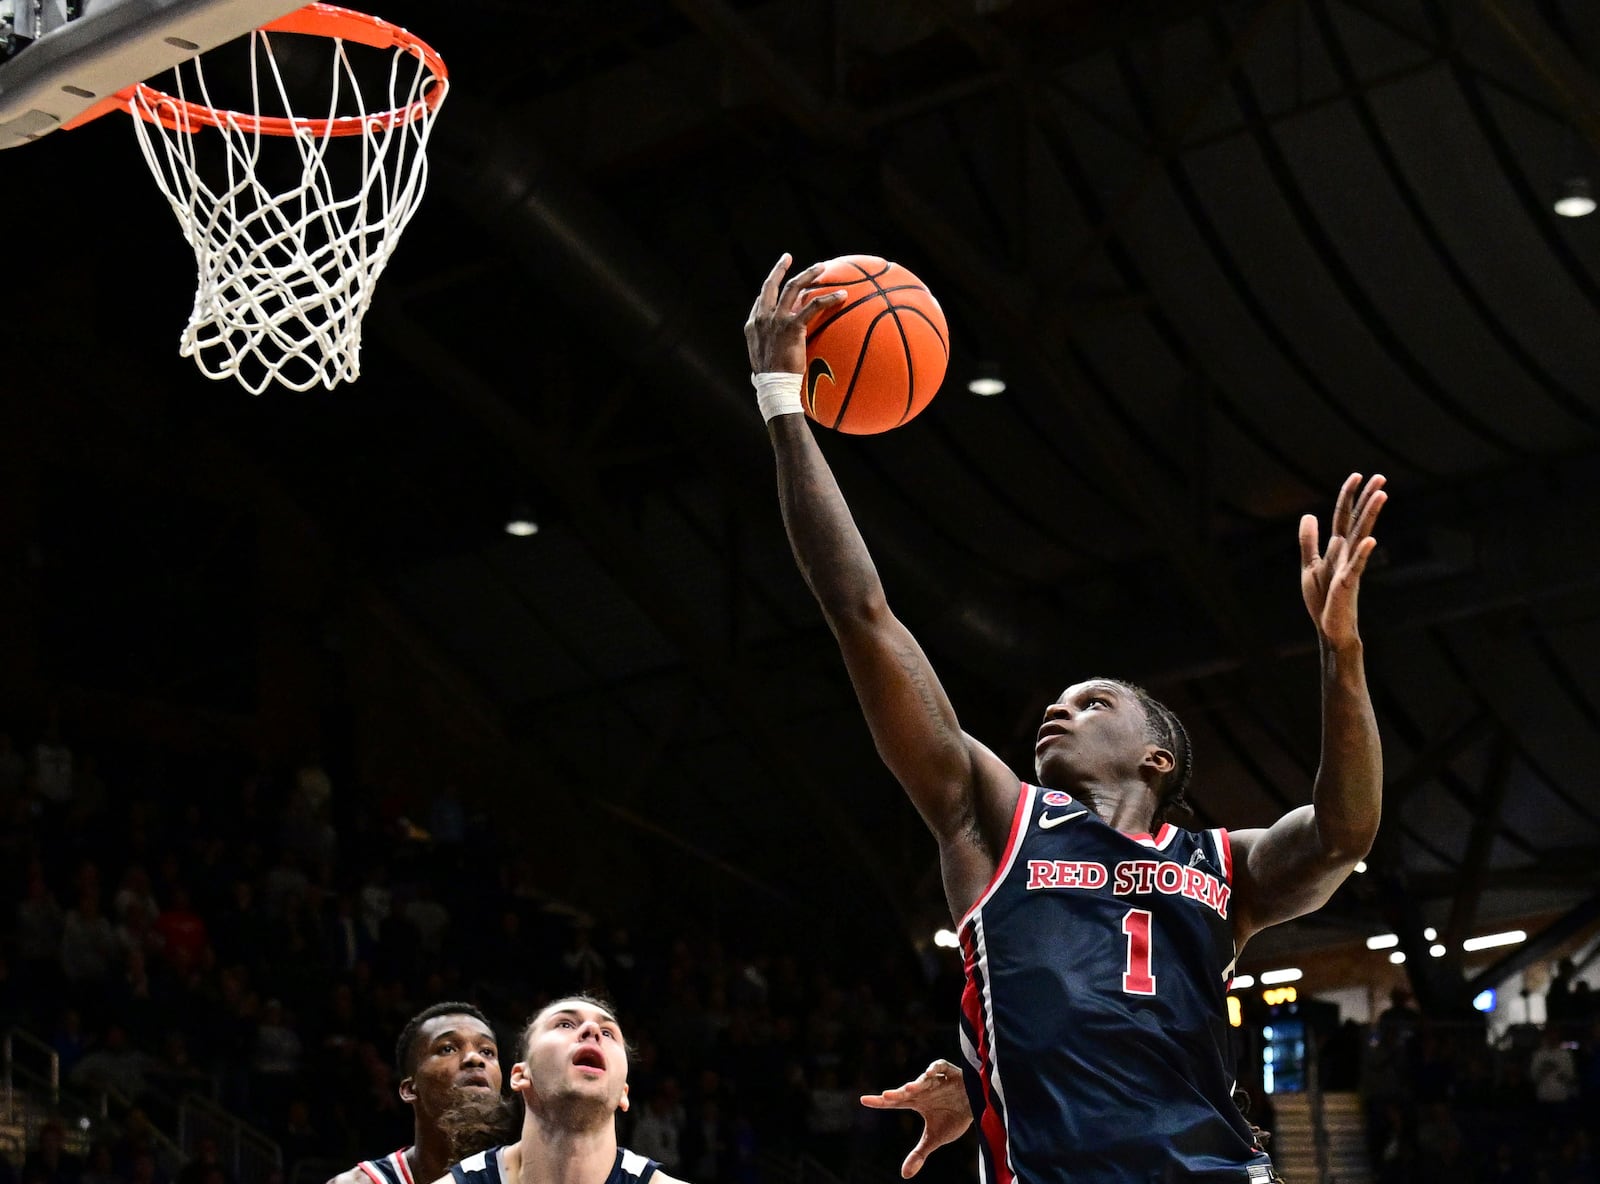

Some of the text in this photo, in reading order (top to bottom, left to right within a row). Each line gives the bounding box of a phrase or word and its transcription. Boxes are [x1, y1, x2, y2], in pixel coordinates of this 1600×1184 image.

[1026, 859, 1232, 920] RED STORM
[1121, 908, 1156, 996] 1
